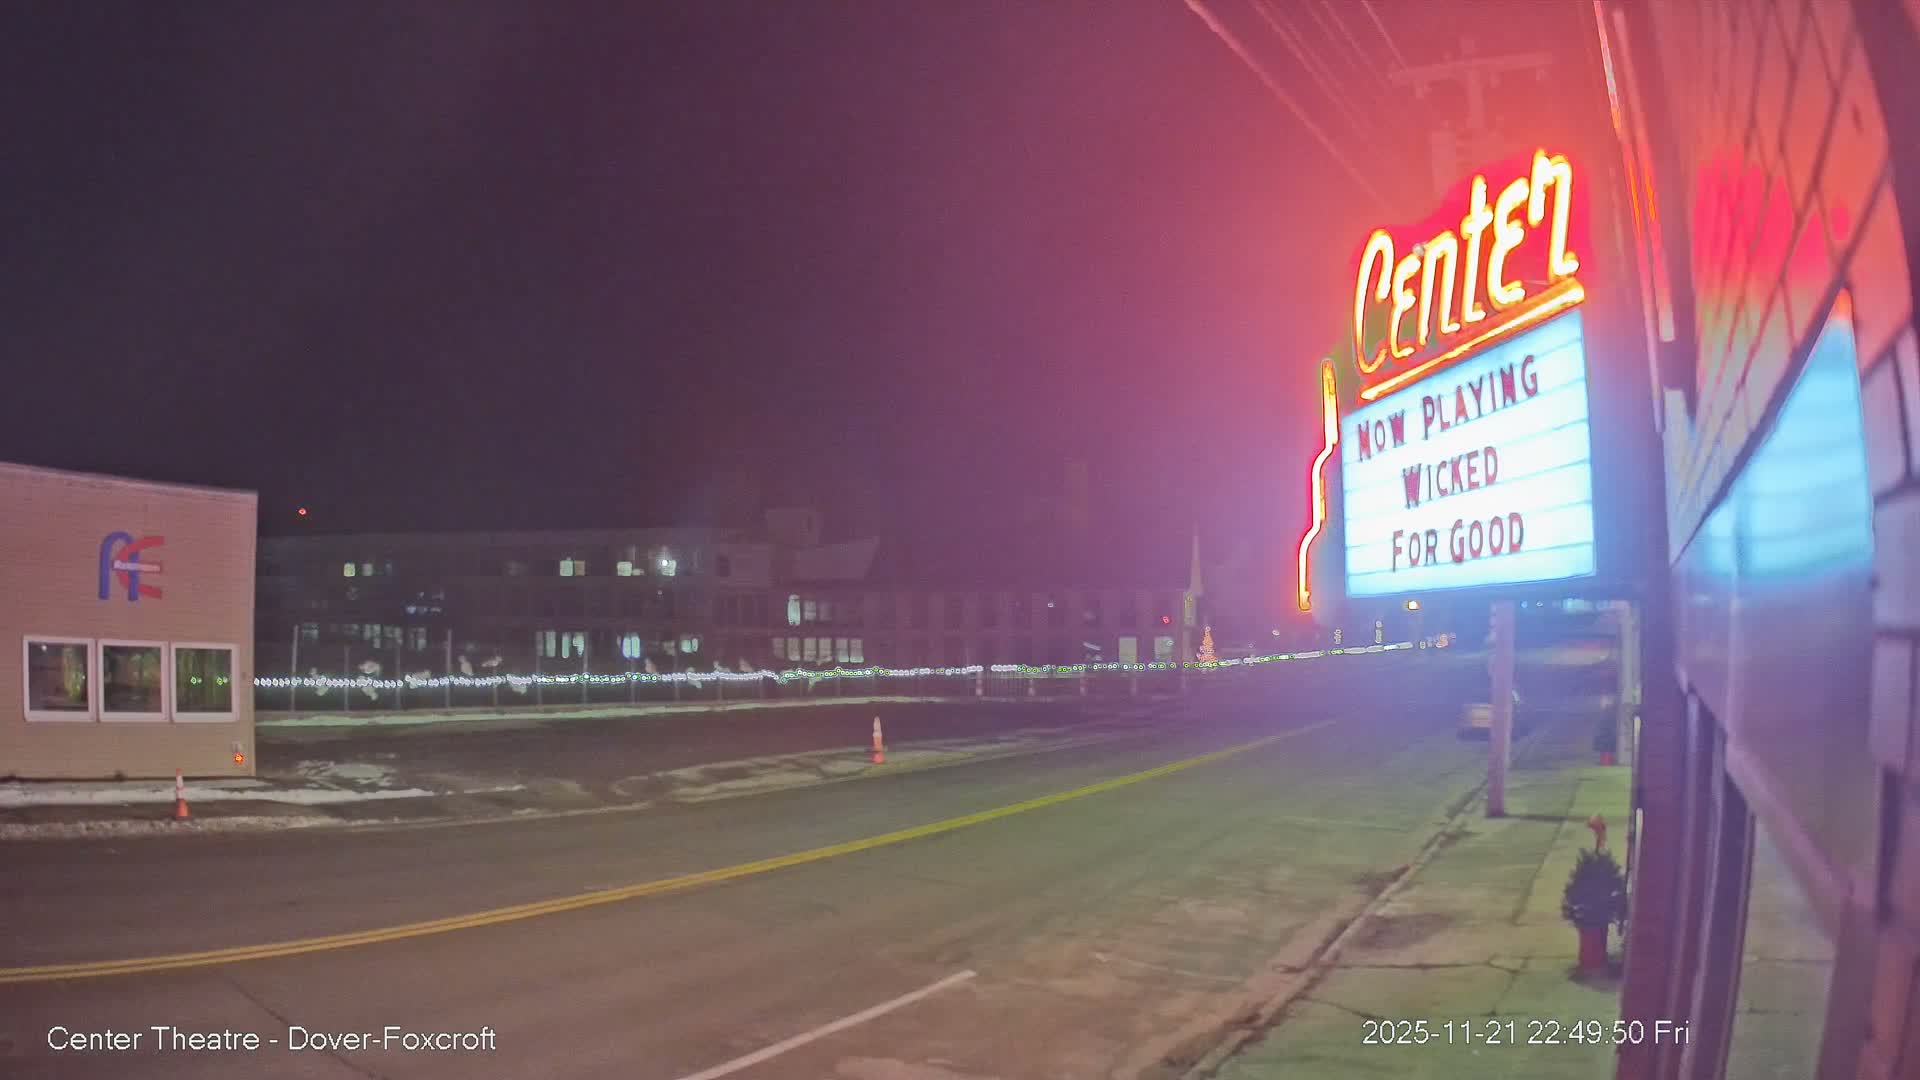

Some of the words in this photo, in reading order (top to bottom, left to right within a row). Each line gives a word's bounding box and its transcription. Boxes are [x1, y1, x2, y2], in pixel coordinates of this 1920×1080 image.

[1421, 354, 1539, 440] PLAYING
[1402, 446, 1498, 509] WICKED
[1449, 512, 1524, 563] GOOD
